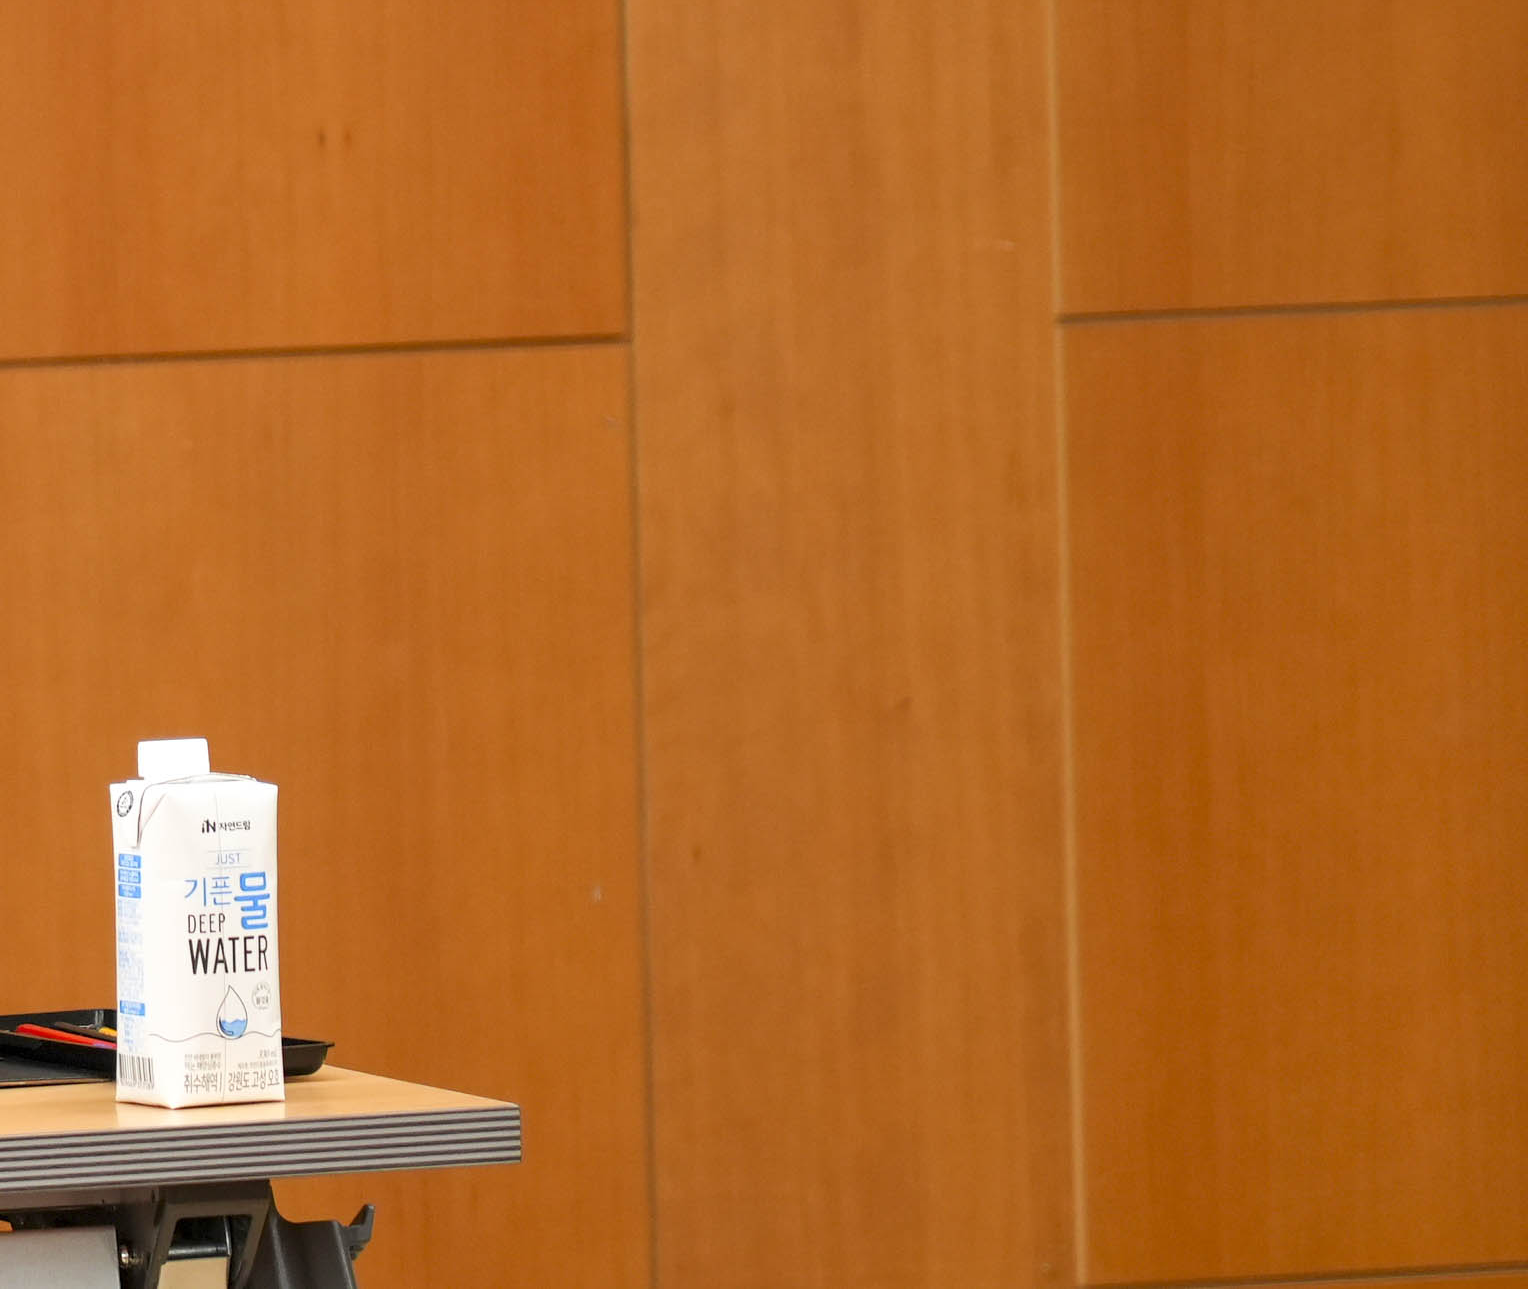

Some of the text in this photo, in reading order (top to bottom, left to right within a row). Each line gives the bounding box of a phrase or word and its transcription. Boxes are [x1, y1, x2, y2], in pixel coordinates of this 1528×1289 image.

[215, 852, 241, 866] JUST
[184, 872, 270, 930] 기픈 물
[187, 913, 226, 934] DEEP
[188, 935, 269, 975] WATER
[228, 1070, 250, 1092] 강원도
[251, 1069, 267, 1090] 고성
